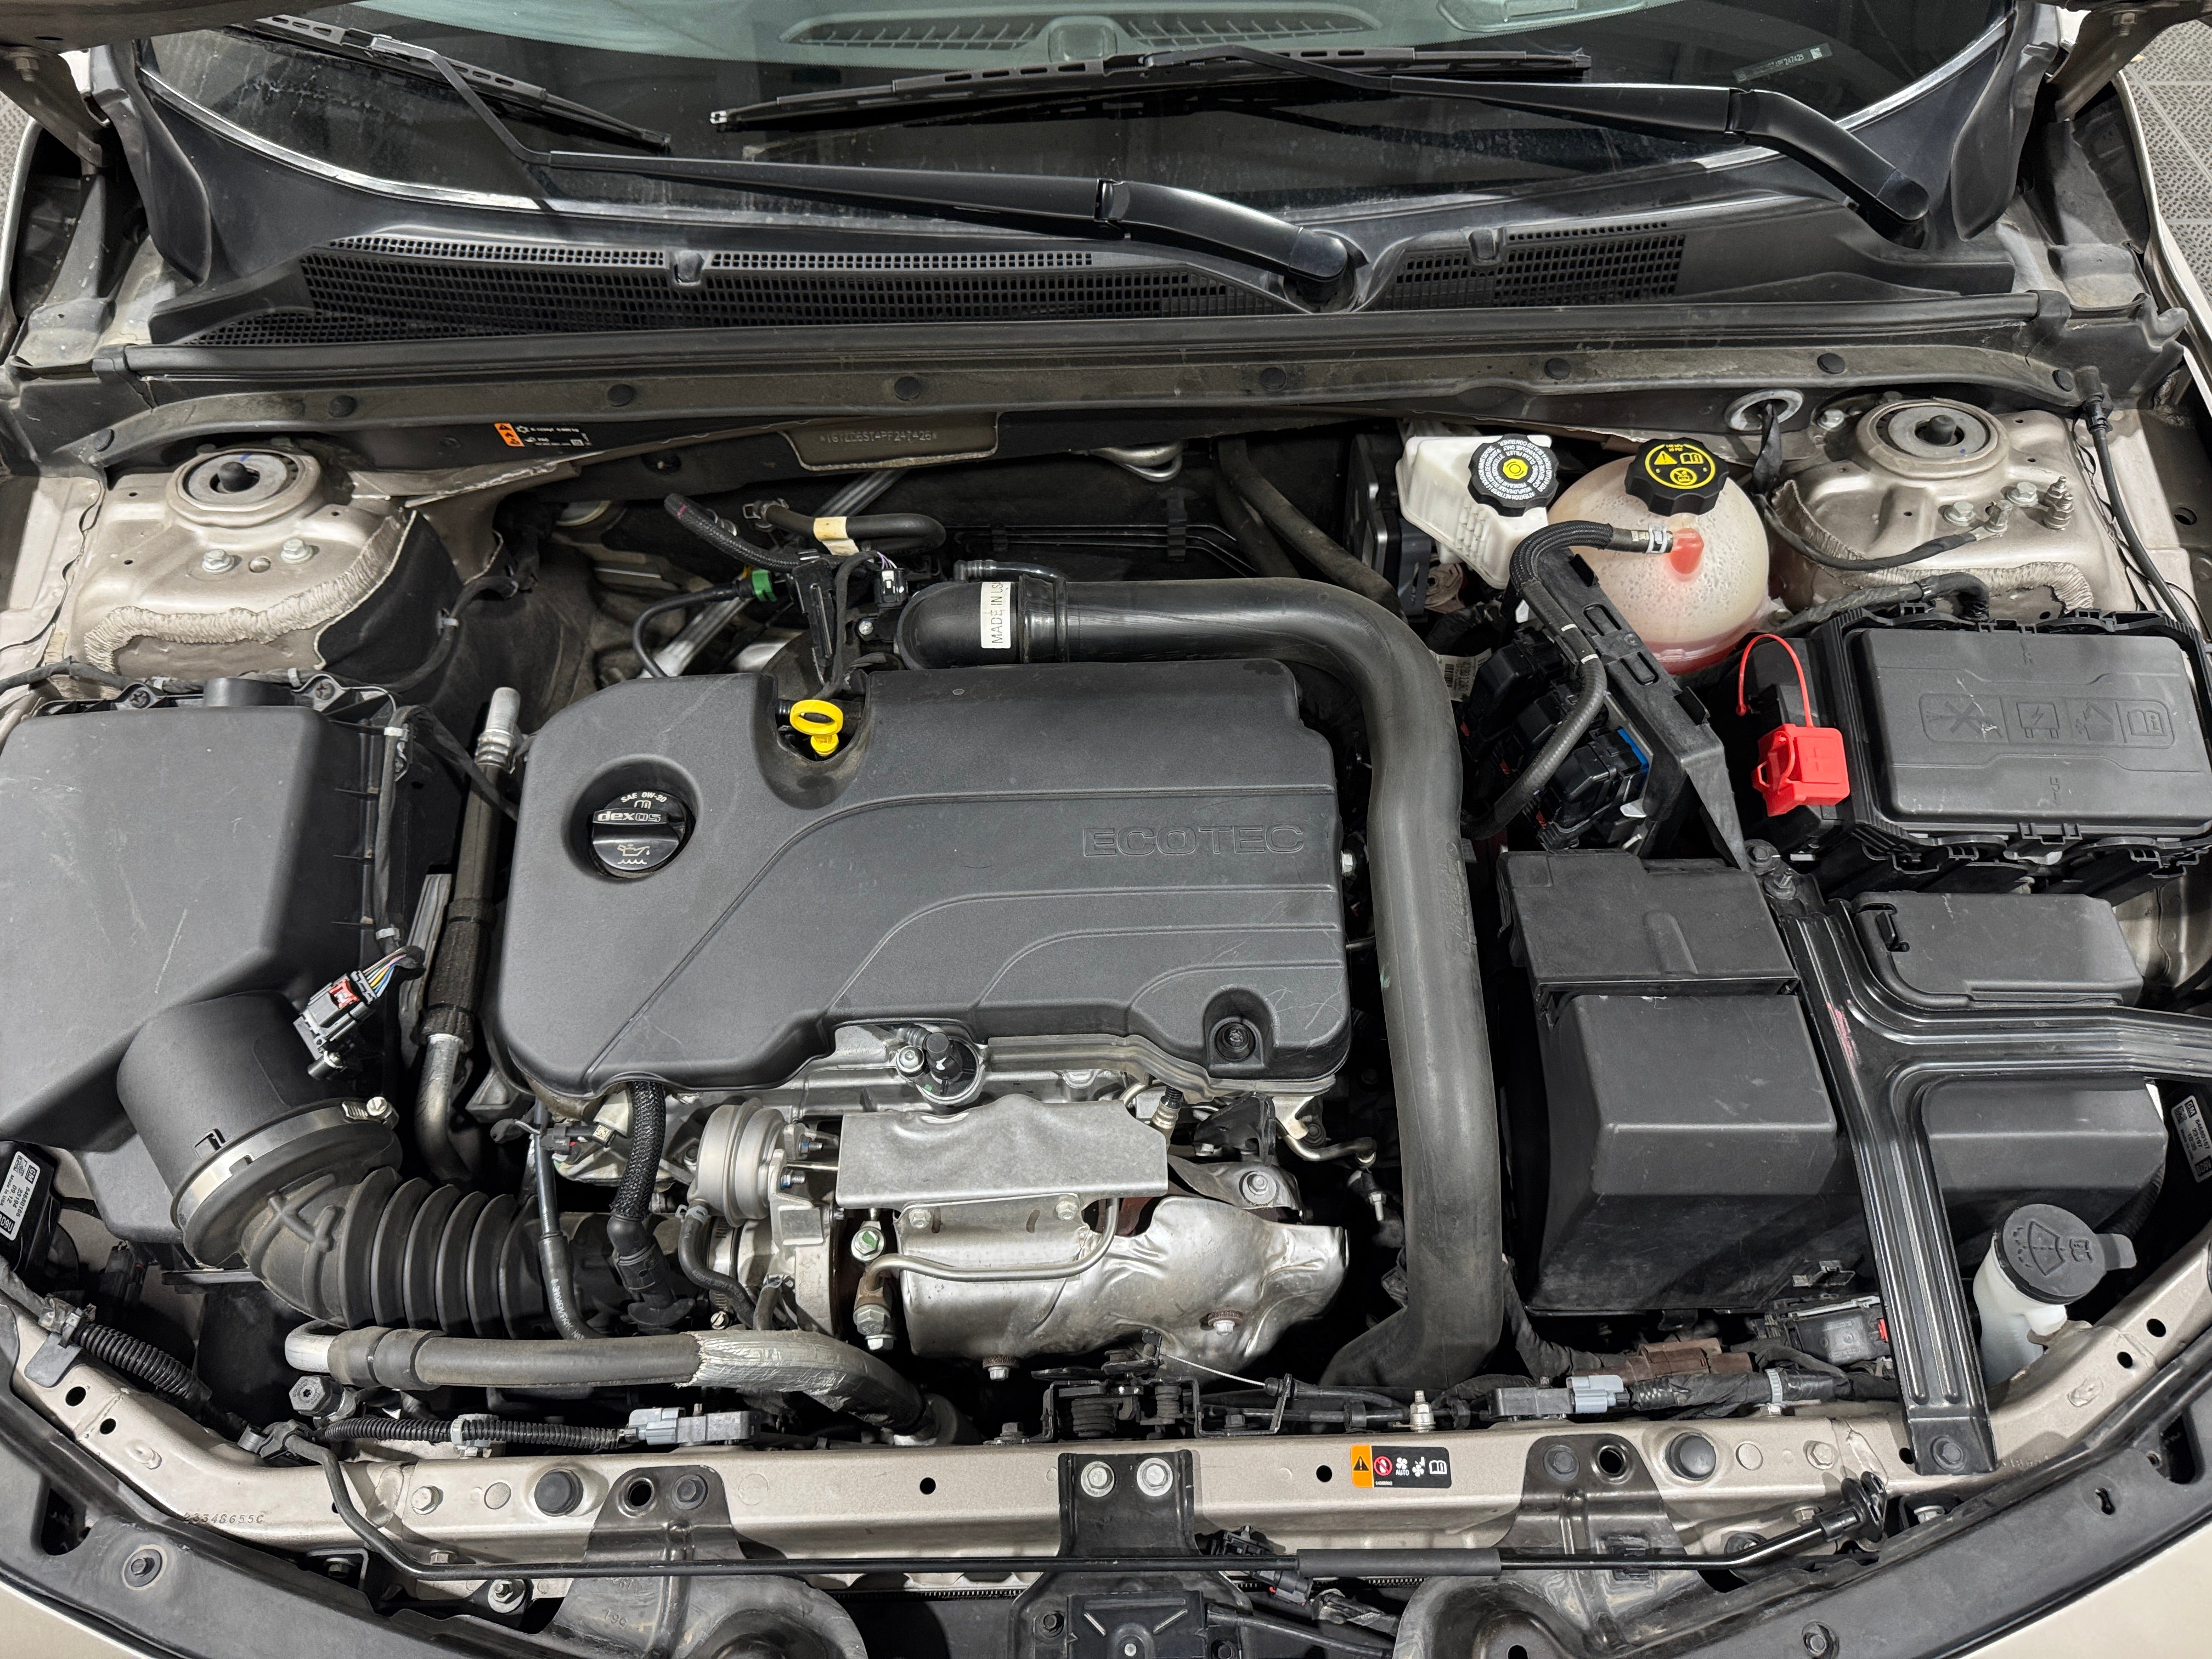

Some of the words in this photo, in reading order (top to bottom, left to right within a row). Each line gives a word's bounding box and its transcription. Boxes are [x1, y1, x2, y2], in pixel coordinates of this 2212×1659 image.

[1528, 442, 1545, 455] SEALED
[1522, 453, 1537, 465] CLEAN
[1544, 457, 1552, 469] FROM
[991, 582, 1003, 595] USA
[991, 596, 1003, 606] IN
[991, 610, 1003, 644] MADE
[620, 792, 637, 803] SAE
[641, 792, 667, 803] 0W-20
[597, 811, 661, 822] dexos
[1083, 824, 1304, 857] ECOTEC
[2187, 1102, 2196, 1115] GM
[27, 1167, 36, 1182] GM
[13, 1187, 23, 1208] 23194
